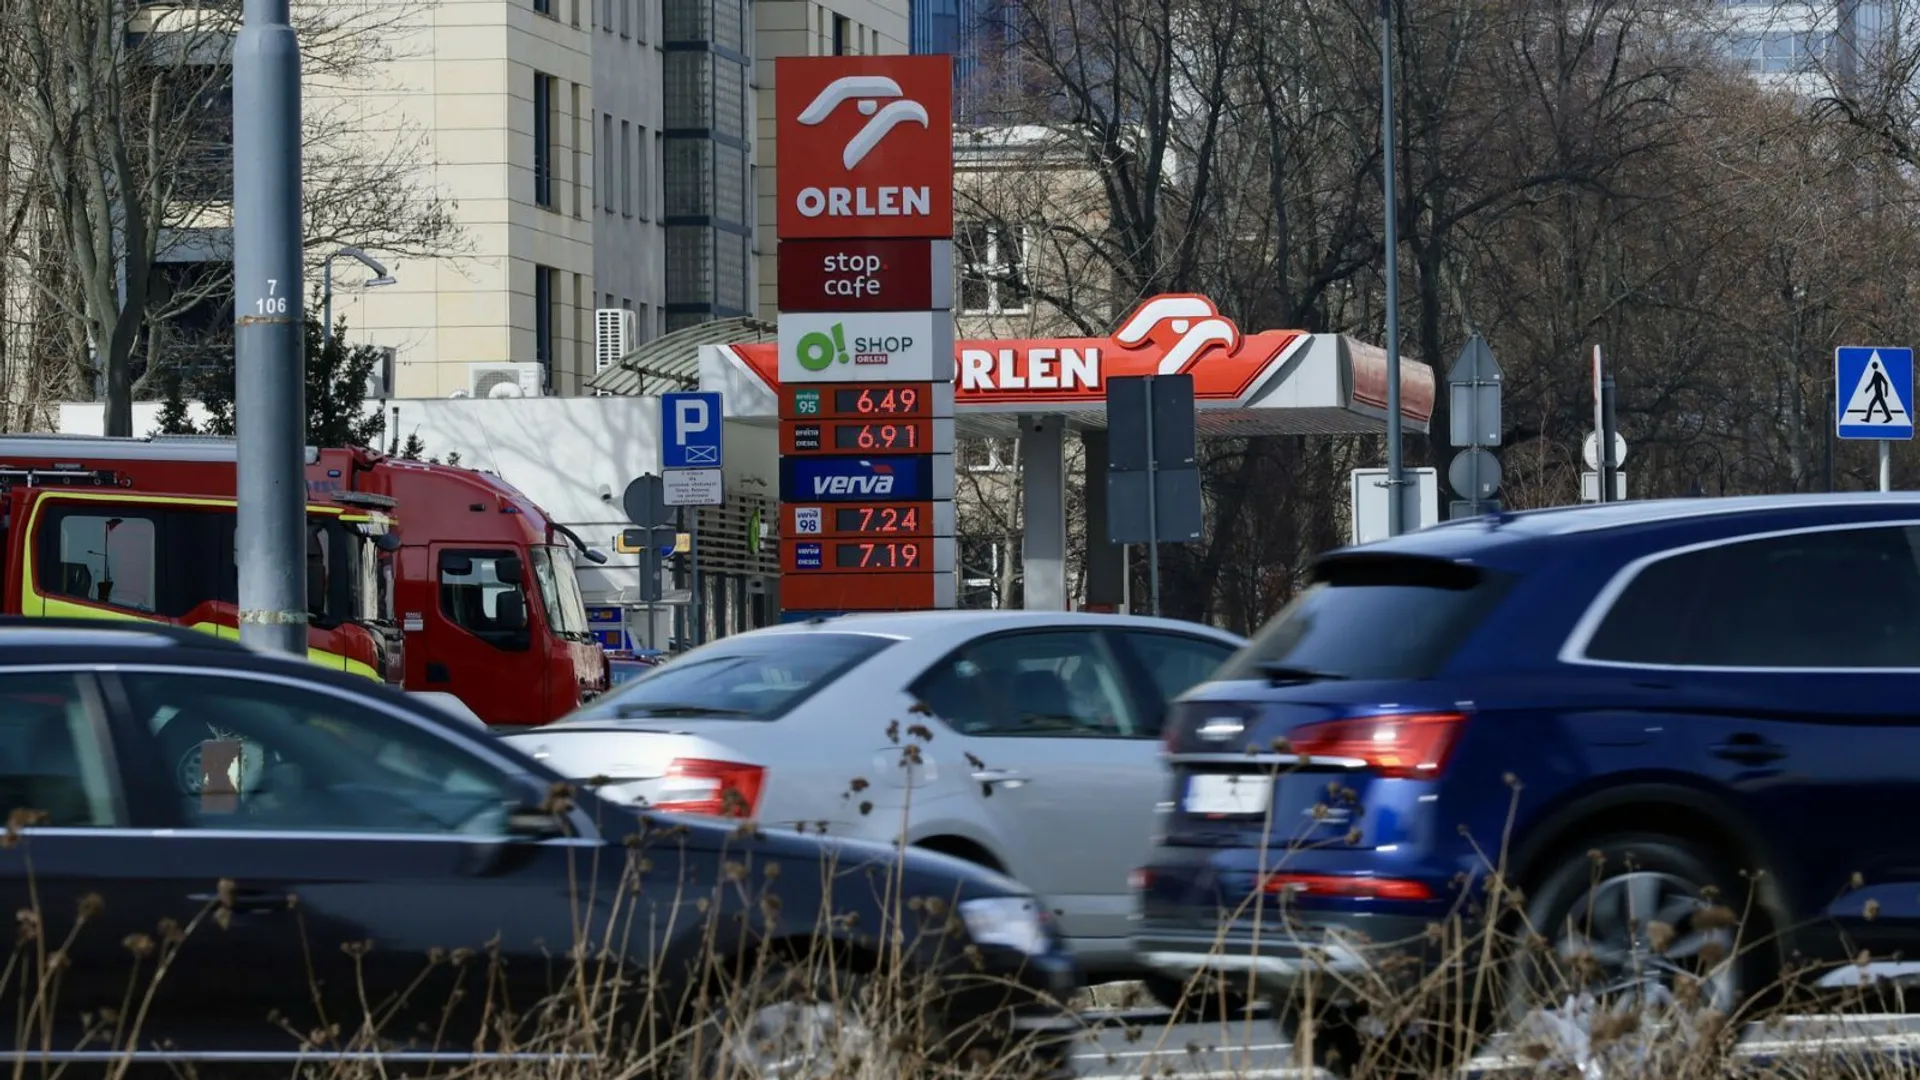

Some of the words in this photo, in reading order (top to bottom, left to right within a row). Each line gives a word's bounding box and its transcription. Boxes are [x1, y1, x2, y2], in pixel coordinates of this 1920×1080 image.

[796, 186, 930, 217] ORLEN
[267, 279, 277, 296] 7
[824, 275, 880, 297] cafe
[256, 297, 286, 315] 106
[854, 336, 914, 353] SHOP
[856, 355, 887, 363] ORLEN
[954, 348, 1099, 390] RLEN
[799, 400, 817, 413] 95
[856, 388, 916, 413] 6.49
[675, 399, 709, 446] P
[857, 424, 915, 448] 6.91
[813, 475, 894, 495] verva
[799, 519, 817, 531] 98
[859, 507, 917, 531] 7.24
[859, 543, 917, 568] 7.19
